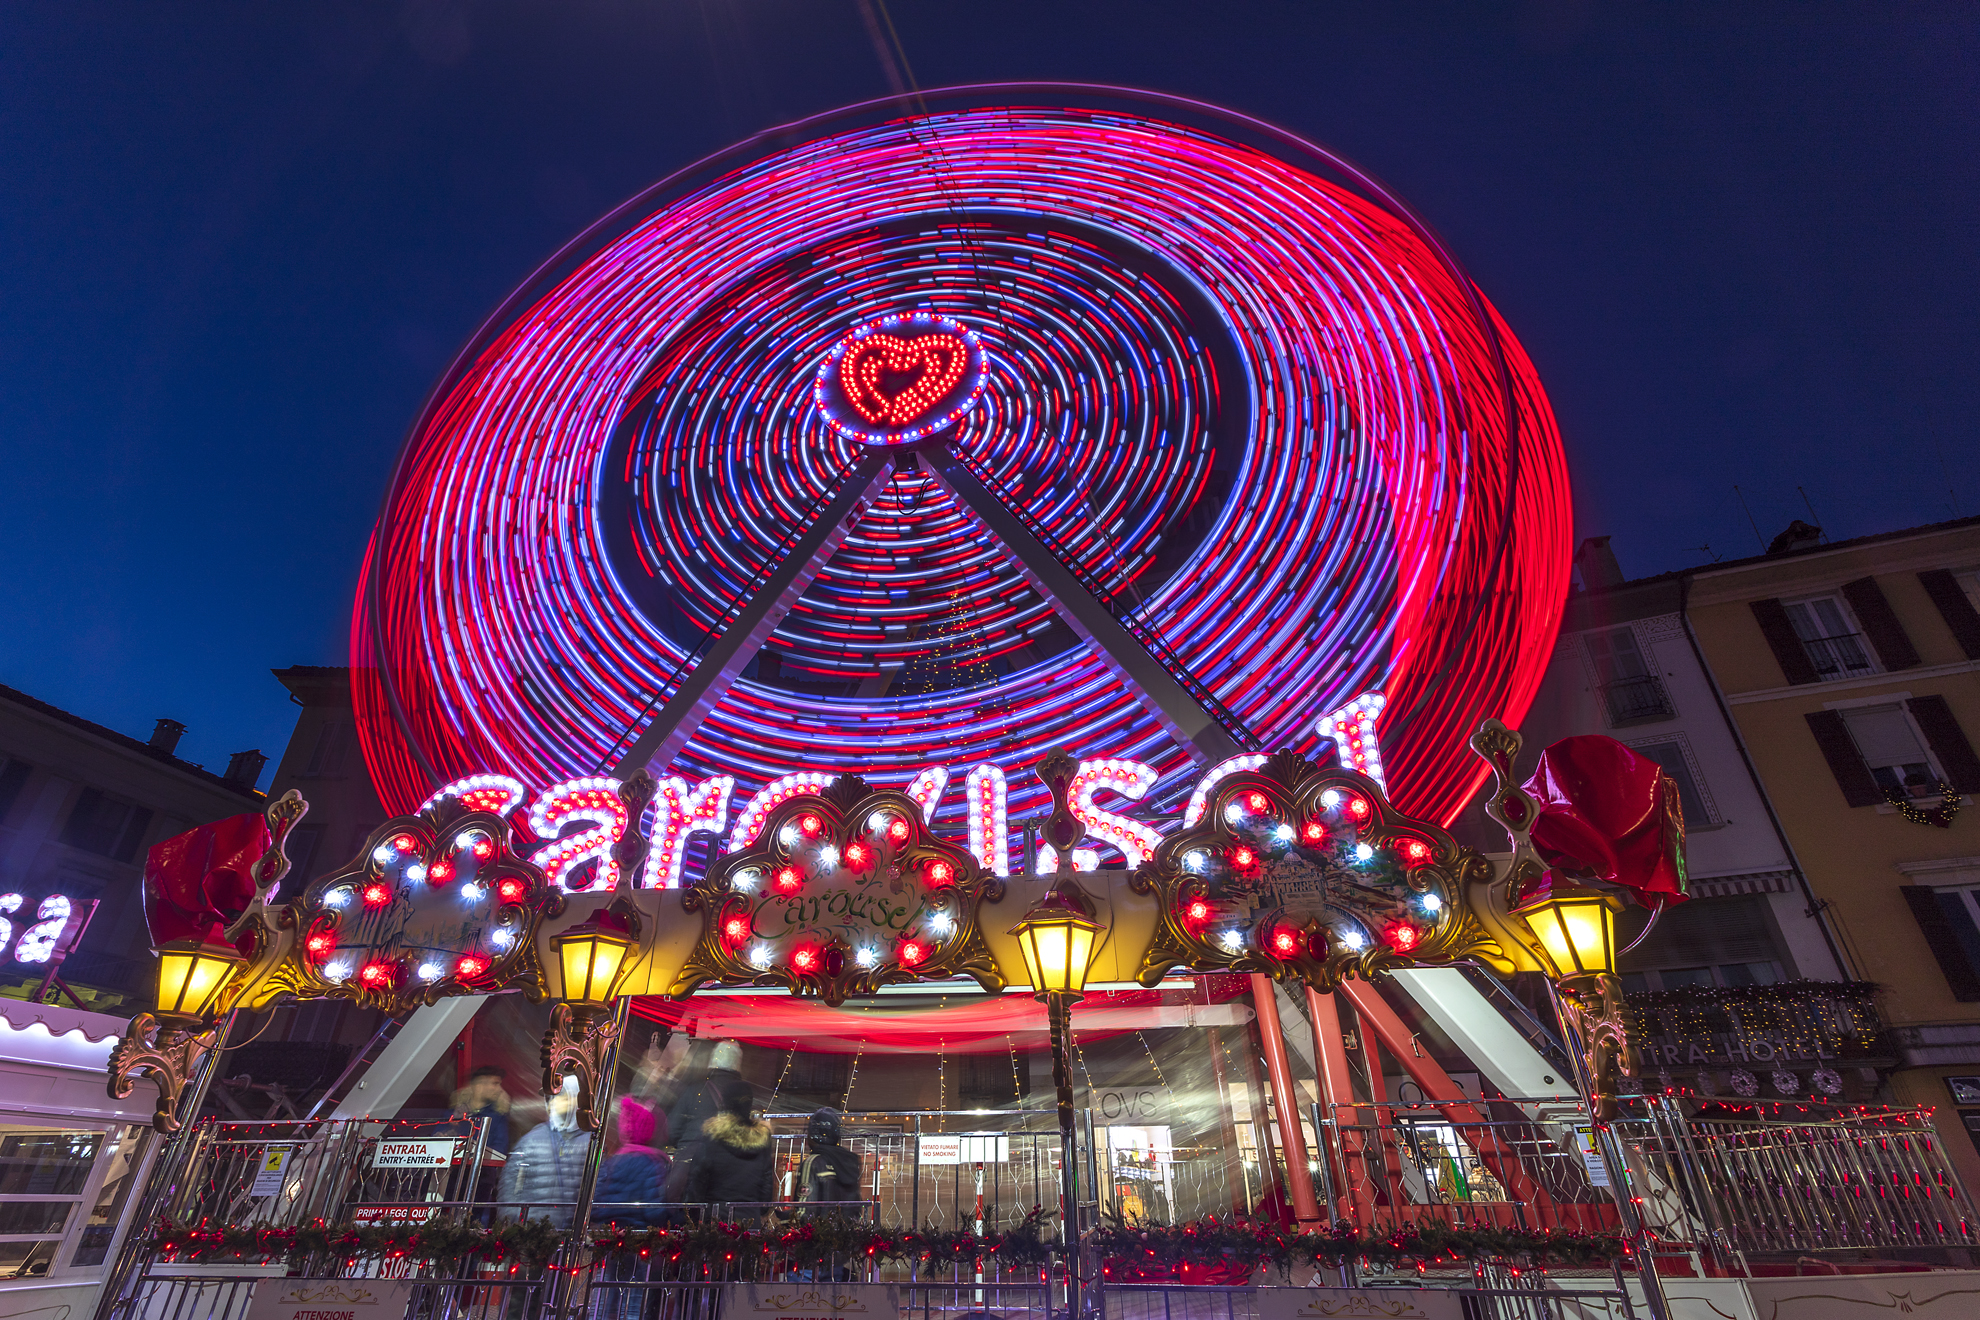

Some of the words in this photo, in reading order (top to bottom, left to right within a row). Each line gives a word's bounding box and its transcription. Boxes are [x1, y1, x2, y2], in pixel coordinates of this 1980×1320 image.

[414, 690, 1388, 893] arusl
[750, 890, 928, 940] Carousel
[1637, 1044, 1709, 1066] TRA
[1724, 1038, 1836, 1063] HOTEL
[1102, 1091, 1157, 1119] OVS
[381, 1144, 427, 1155] ENTRATA
[384, 1208, 408, 1218] LEGG
[292, 1310, 355, 1320] ATTENZIONE
